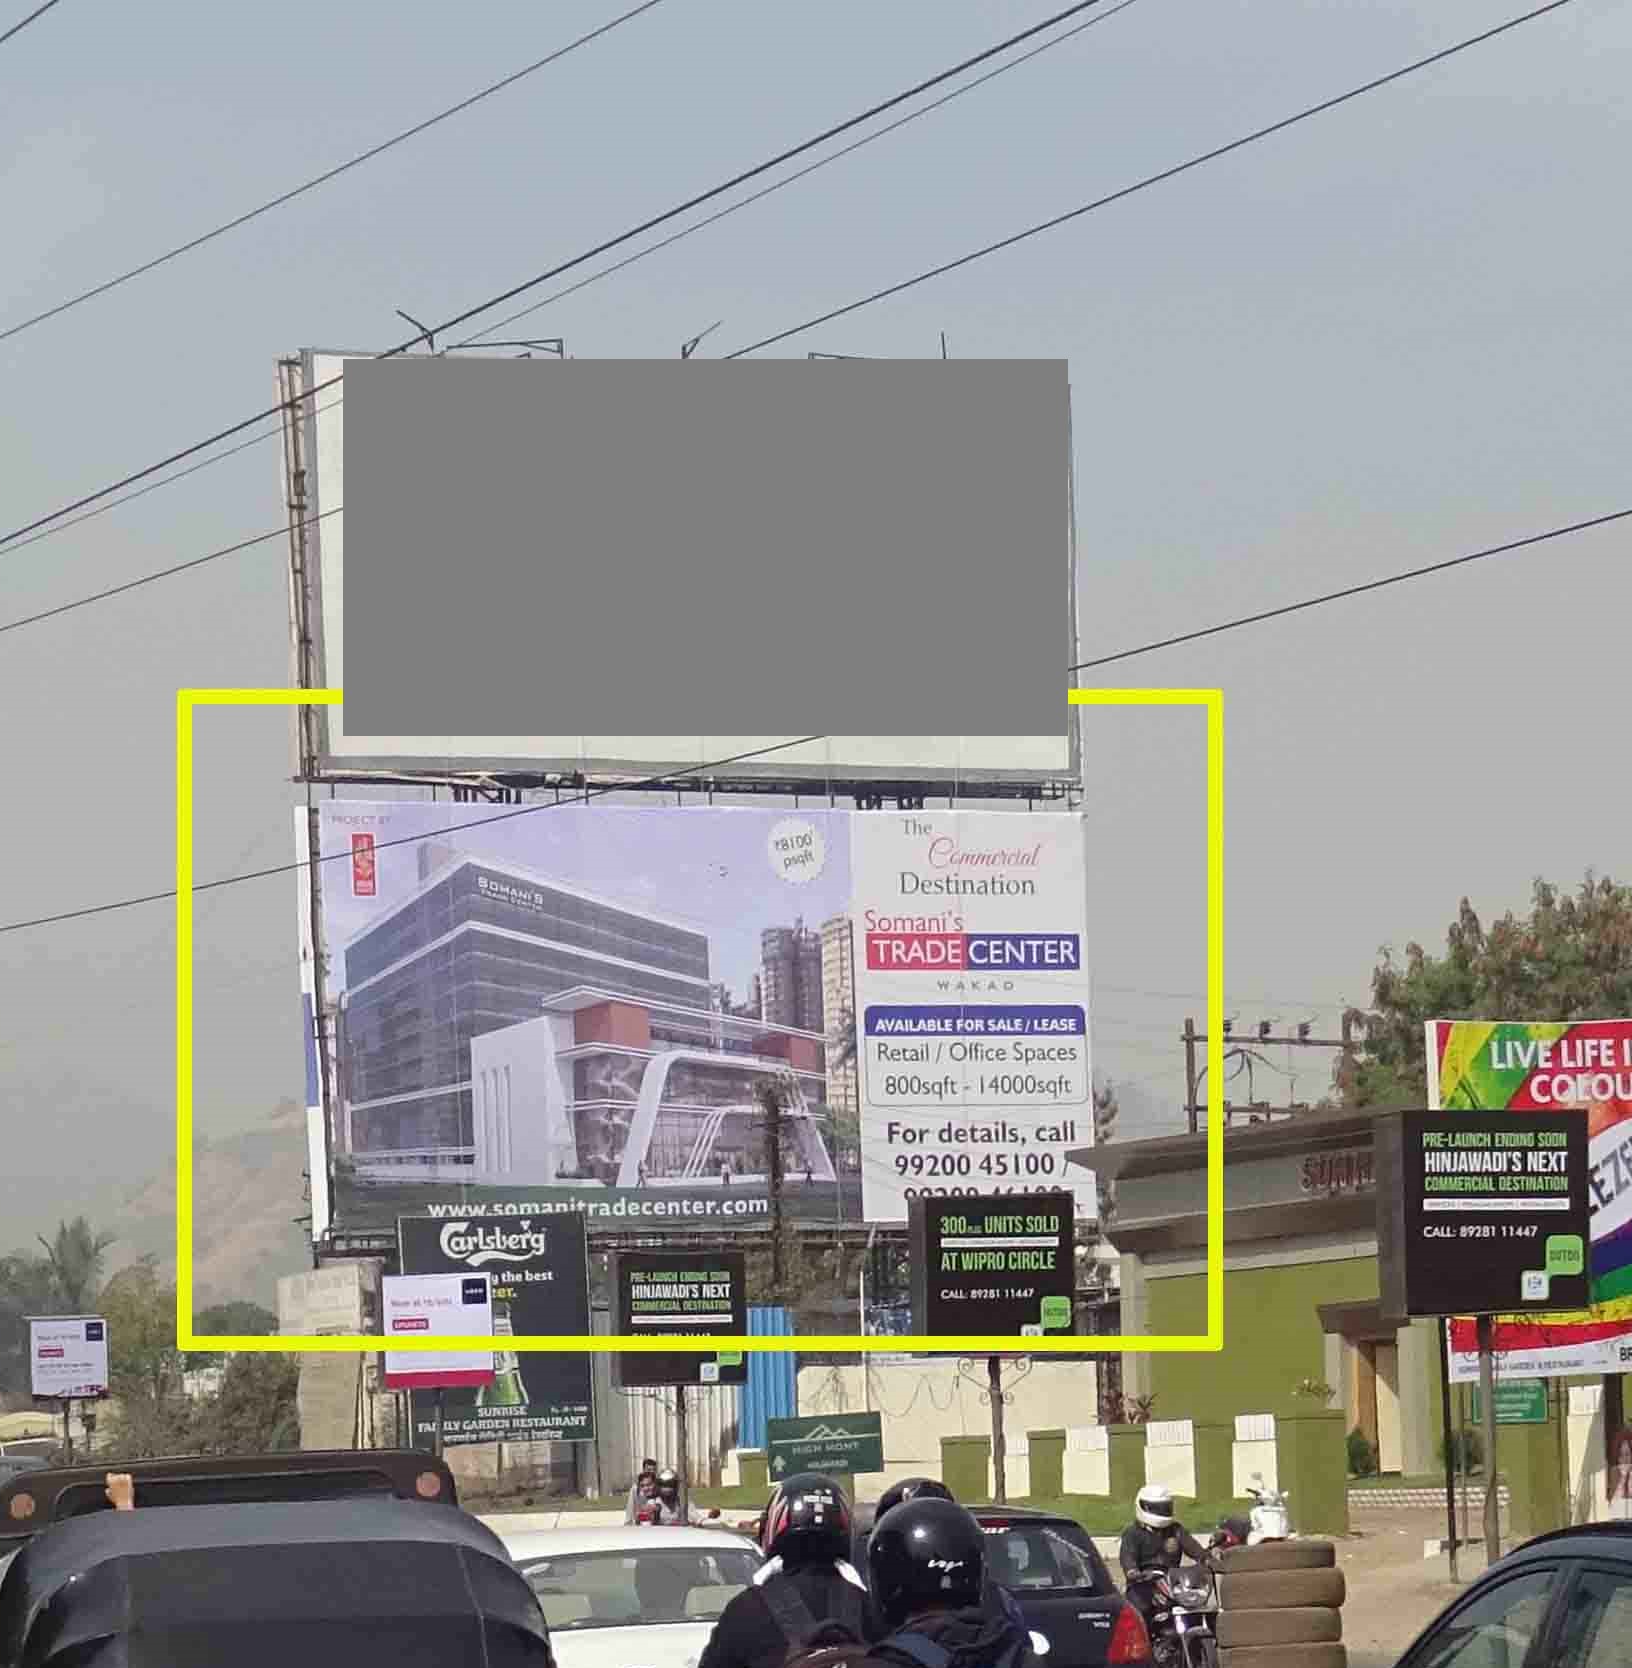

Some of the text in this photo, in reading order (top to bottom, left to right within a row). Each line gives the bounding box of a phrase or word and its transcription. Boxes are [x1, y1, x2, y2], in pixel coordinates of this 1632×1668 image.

[901, 818, 933, 836] The
[928, 837, 1041, 869] Commercial
[899, 871, 1035, 895] Destination
[864, 909, 964, 932] Somani's
[871, 939, 1076, 964] TRADE CENTER
[936, 980, 1015, 991] WAKAD
[874, 1019, 953, 1032] AVAILABLE
[956, 1019, 985, 1032] FOR
[987, 1019, 1023, 1032] SALE
[1033, 1018, 1077, 1031] LEASE
[877, 1042, 929, 1062] Retail
[949, 1042, 1007, 1062] Office
[1013, 1041, 1077, 1065] Spaces
[1490, 1039, 1553, 1070] LIVE
[1560, 1038, 1616, 1069] LIFE
[885, 1075, 958, 1101] 800sqft
[979, 1074, 1072, 1099] 14000sqft
[887, 1120, 1075, 1146] For details, call
[1423, 1132, 1567, 1148] PRE-LAUNCH ENDING SOON
[894, 1153, 971, 1177] 99200
[978, 1153, 1055, 1176] 45100
[1424, 1151, 1568, 1173] HINJAWADI'S NEXT
[1424, 1175, 1569, 1192] COMMERCIAL DESTINATION
[940, 1215, 967, 1234] 300
[984, 1215, 1023, 1234] UNITS
[1025, 1215, 1059, 1233] SOLD
[1459, 1225, 1496, 1238] 89281
[1501, 1225, 1538, 1237] 11447
[438, 1220, 546, 1258] Carlsberg
[940, 1250, 1056, 1272] AT WIPRO CIRCLE
[501, 1270, 523, 1282] the
[524, 1269, 554, 1282] best
[631, 1283, 732, 1299] HINJAWADI'S NEXT
